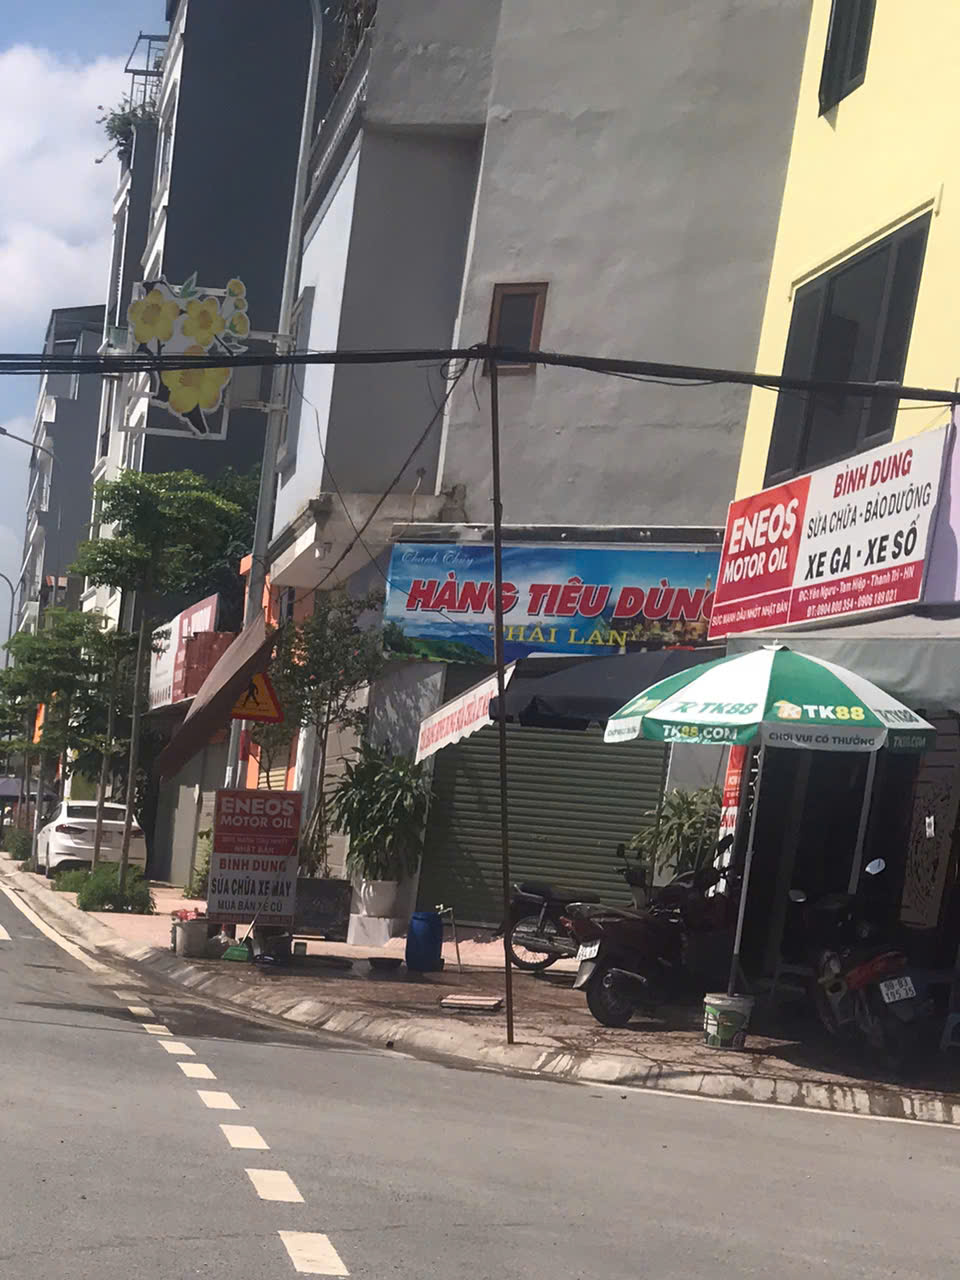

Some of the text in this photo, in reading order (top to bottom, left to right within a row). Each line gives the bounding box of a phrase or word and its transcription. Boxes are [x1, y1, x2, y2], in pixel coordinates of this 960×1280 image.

[833, 449, 913, 498] BÌNH DUNG
[807, 482, 931, 539] SỬA CHỮA BẢO DƯỠNG
[728, 498, 799, 555] ENEOS
[804, 513, 920, 581] XE GA XE SỐ
[722, 545, 789, 584] MOTOR OIL
[405, 570, 520, 615] HÀNG
[527, 576, 611, 618] TIÊU
[568, 628, 628, 647] LAN
[698, 702, 758, 715] TK88
[802, 704, 865, 721] TK88
[769, 732, 875, 746] CHƠI VUI CÓ THƯỞNG
[220, 797, 295, 816] ENEOS
[220, 815, 293, 829] MOTOR OIL
[219, 857, 287, 873] BÌNH DUNG
[258, 880, 270, 897] XE
[218, 900, 236, 911] MUA
